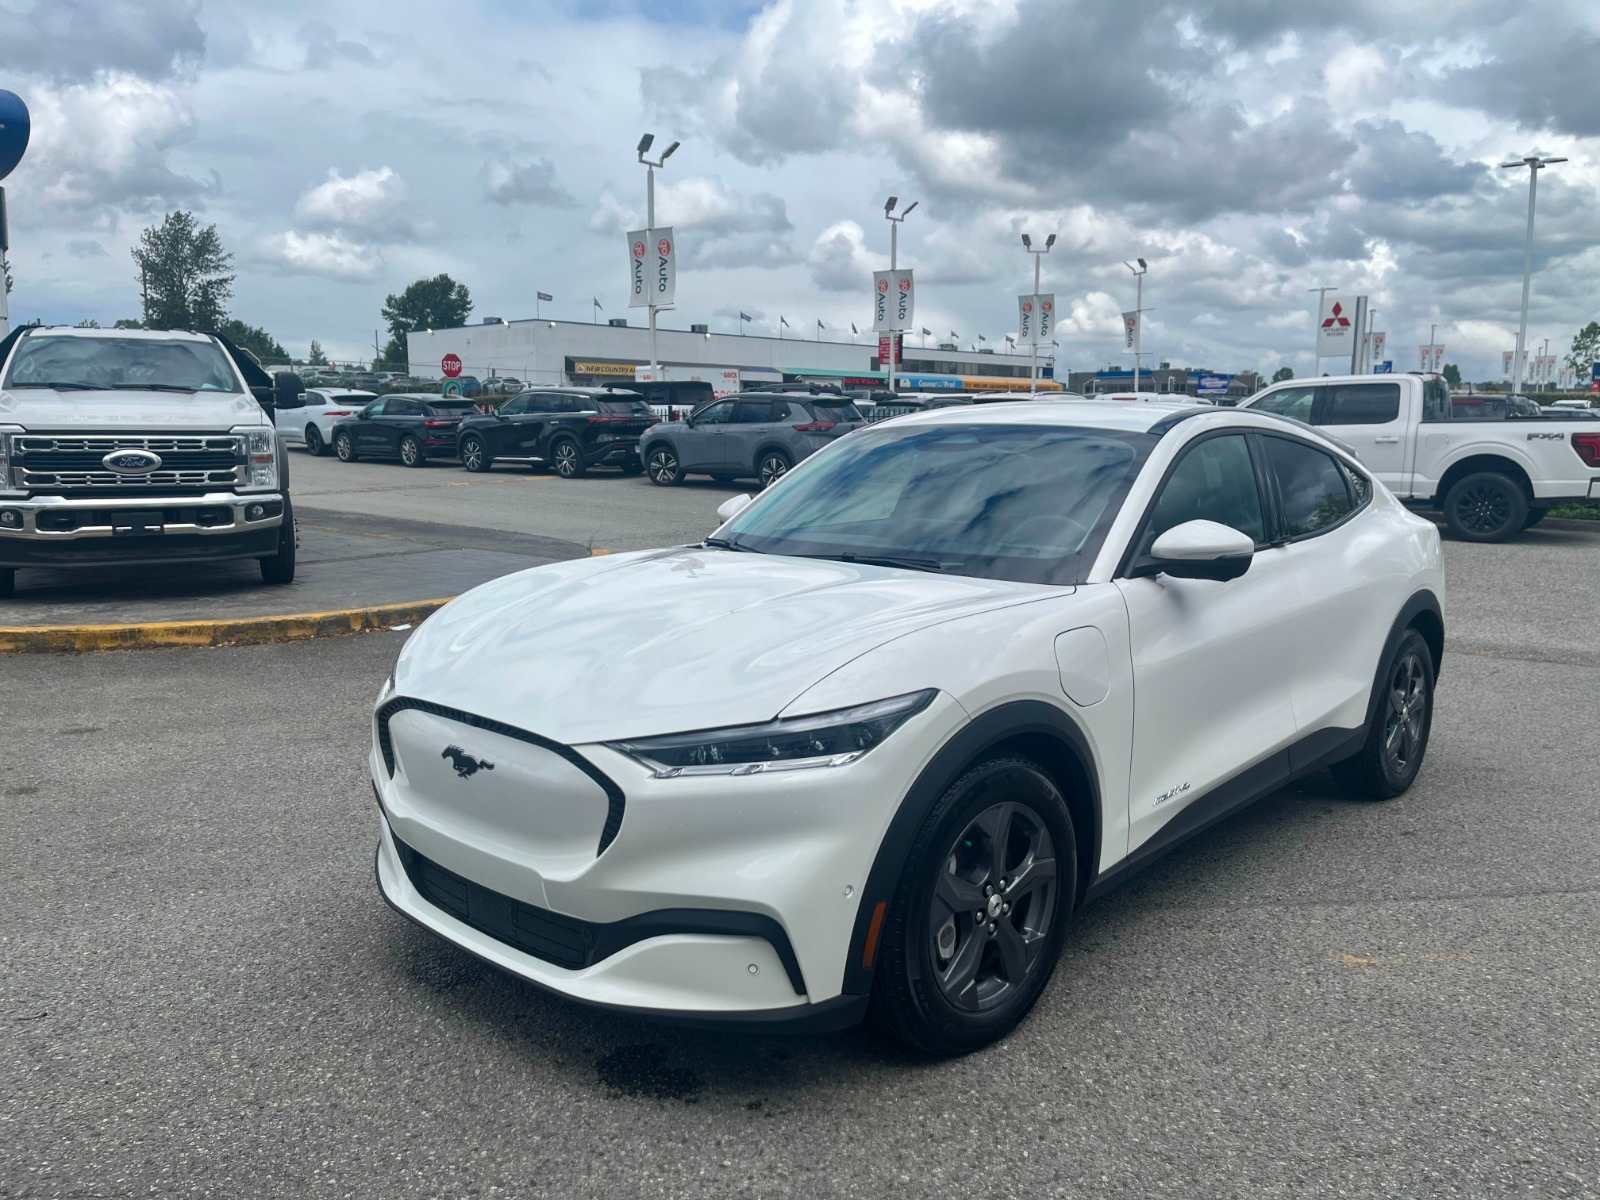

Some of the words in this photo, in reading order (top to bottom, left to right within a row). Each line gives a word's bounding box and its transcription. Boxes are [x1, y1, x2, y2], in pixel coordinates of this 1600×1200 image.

[635, 259, 643, 294] Auto
[658, 257, 668, 292] Auto
[878, 293, 886, 321] Auto
[898, 292, 907, 320] Auto
[1022, 313, 1031, 337] Auto
[1041, 312, 1049, 336] Auto
[443, 361, 460, 371] STOP
[119, 456, 146, 466] Ford
